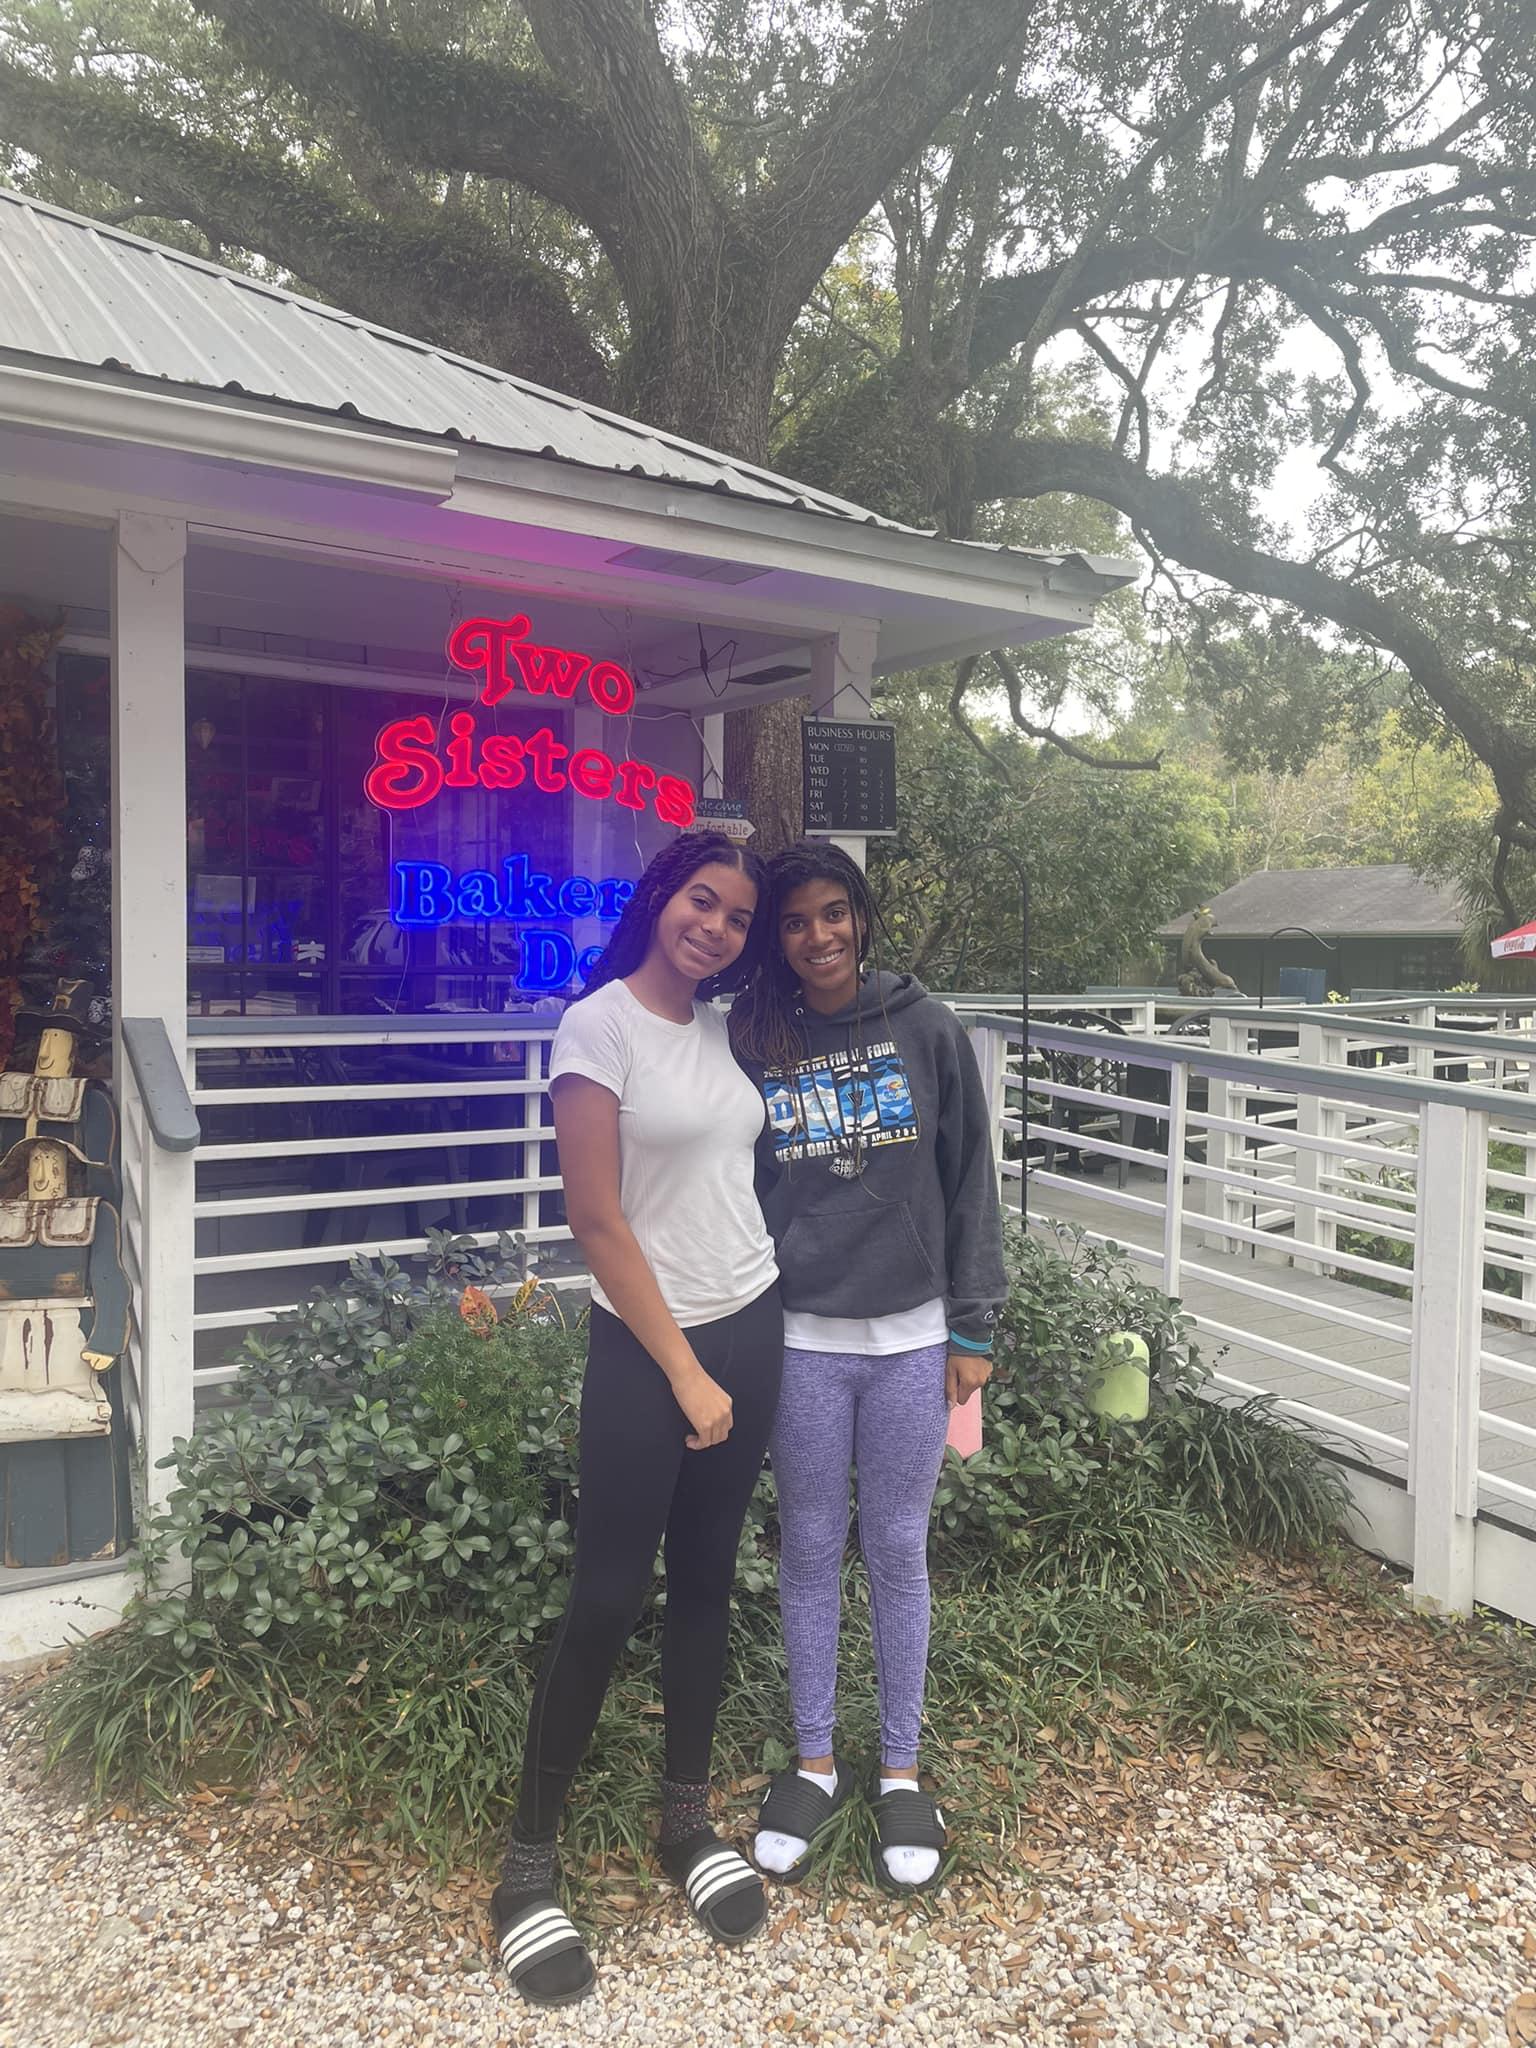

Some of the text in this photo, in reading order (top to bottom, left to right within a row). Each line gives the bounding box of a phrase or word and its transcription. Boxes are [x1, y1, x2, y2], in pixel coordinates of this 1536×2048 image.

[450, 614, 634, 714] Two
[807, 726, 892, 741] BUSINESS HOURS
[809, 742, 830, 752] MON
[809, 753, 825, 763] TUE
[368, 711, 695, 828] Sisters
[809, 765, 830, 775] WED
[841, 767, 848, 775] 7
[809, 777, 829, 787] THU
[809, 789, 823, 799] FRI
[698, 800, 742, 811] elcome
[809, 801, 825, 811] SAT
[842, 802, 849, 811] 7
[809, 813, 827, 823] SUN
[842, 814, 848, 823] 7
[395, 852, 635, 926] Baker
[519, 929, 605, 990] De
[871, 1130, 893, 1143] APRIL
[895, 1129, 901, 1138] 2
